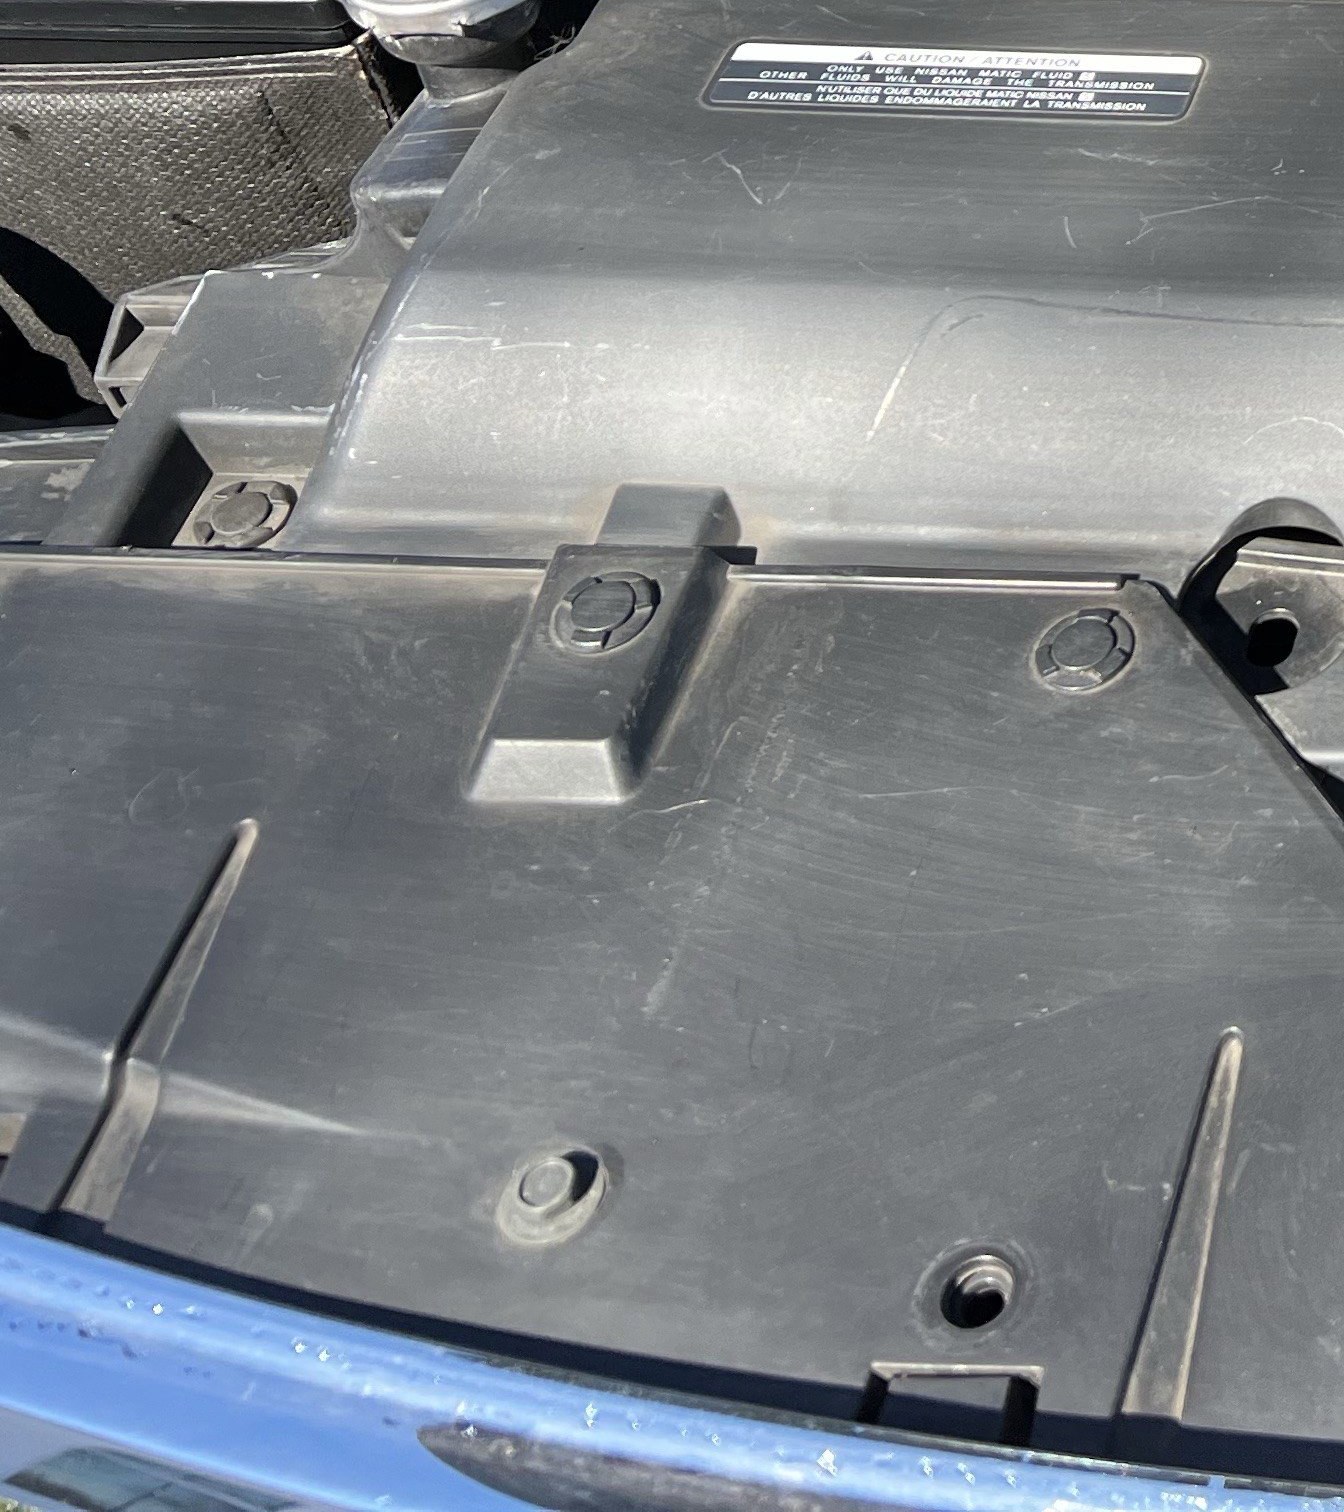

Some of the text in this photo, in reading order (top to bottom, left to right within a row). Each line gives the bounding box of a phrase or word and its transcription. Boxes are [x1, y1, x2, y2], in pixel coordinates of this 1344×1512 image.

[884, 52, 965, 64] CAUTION
[982, 55, 1081, 67] ATTENTION
[759, 70, 1155, 90] OTHER FLUIDS WILL DAMAGE THE TRANSMISSION
[826, 65, 865, 73] ONLY
[875, 66, 903, 75] USE
[915, 68, 968, 76] NISSAN
[978, 70, 1022, 78] MATIC
[1031, 71, 1074, 79] FLUID
[816, 84, 882, 94] N'UTILISER
[883, 86, 911, 95] QUE
[913, 87, 932, 96] DU
[934, 88, 983, 97] LIQUIDE
[985, 90, 1024, 99] MATIC
[1026, 91, 1074, 100] NISSAN
[747, 91, 1147, 111] D'AUTRES LIQUIDES ENDOMMAGERAIENT LA TRANSMISSION
